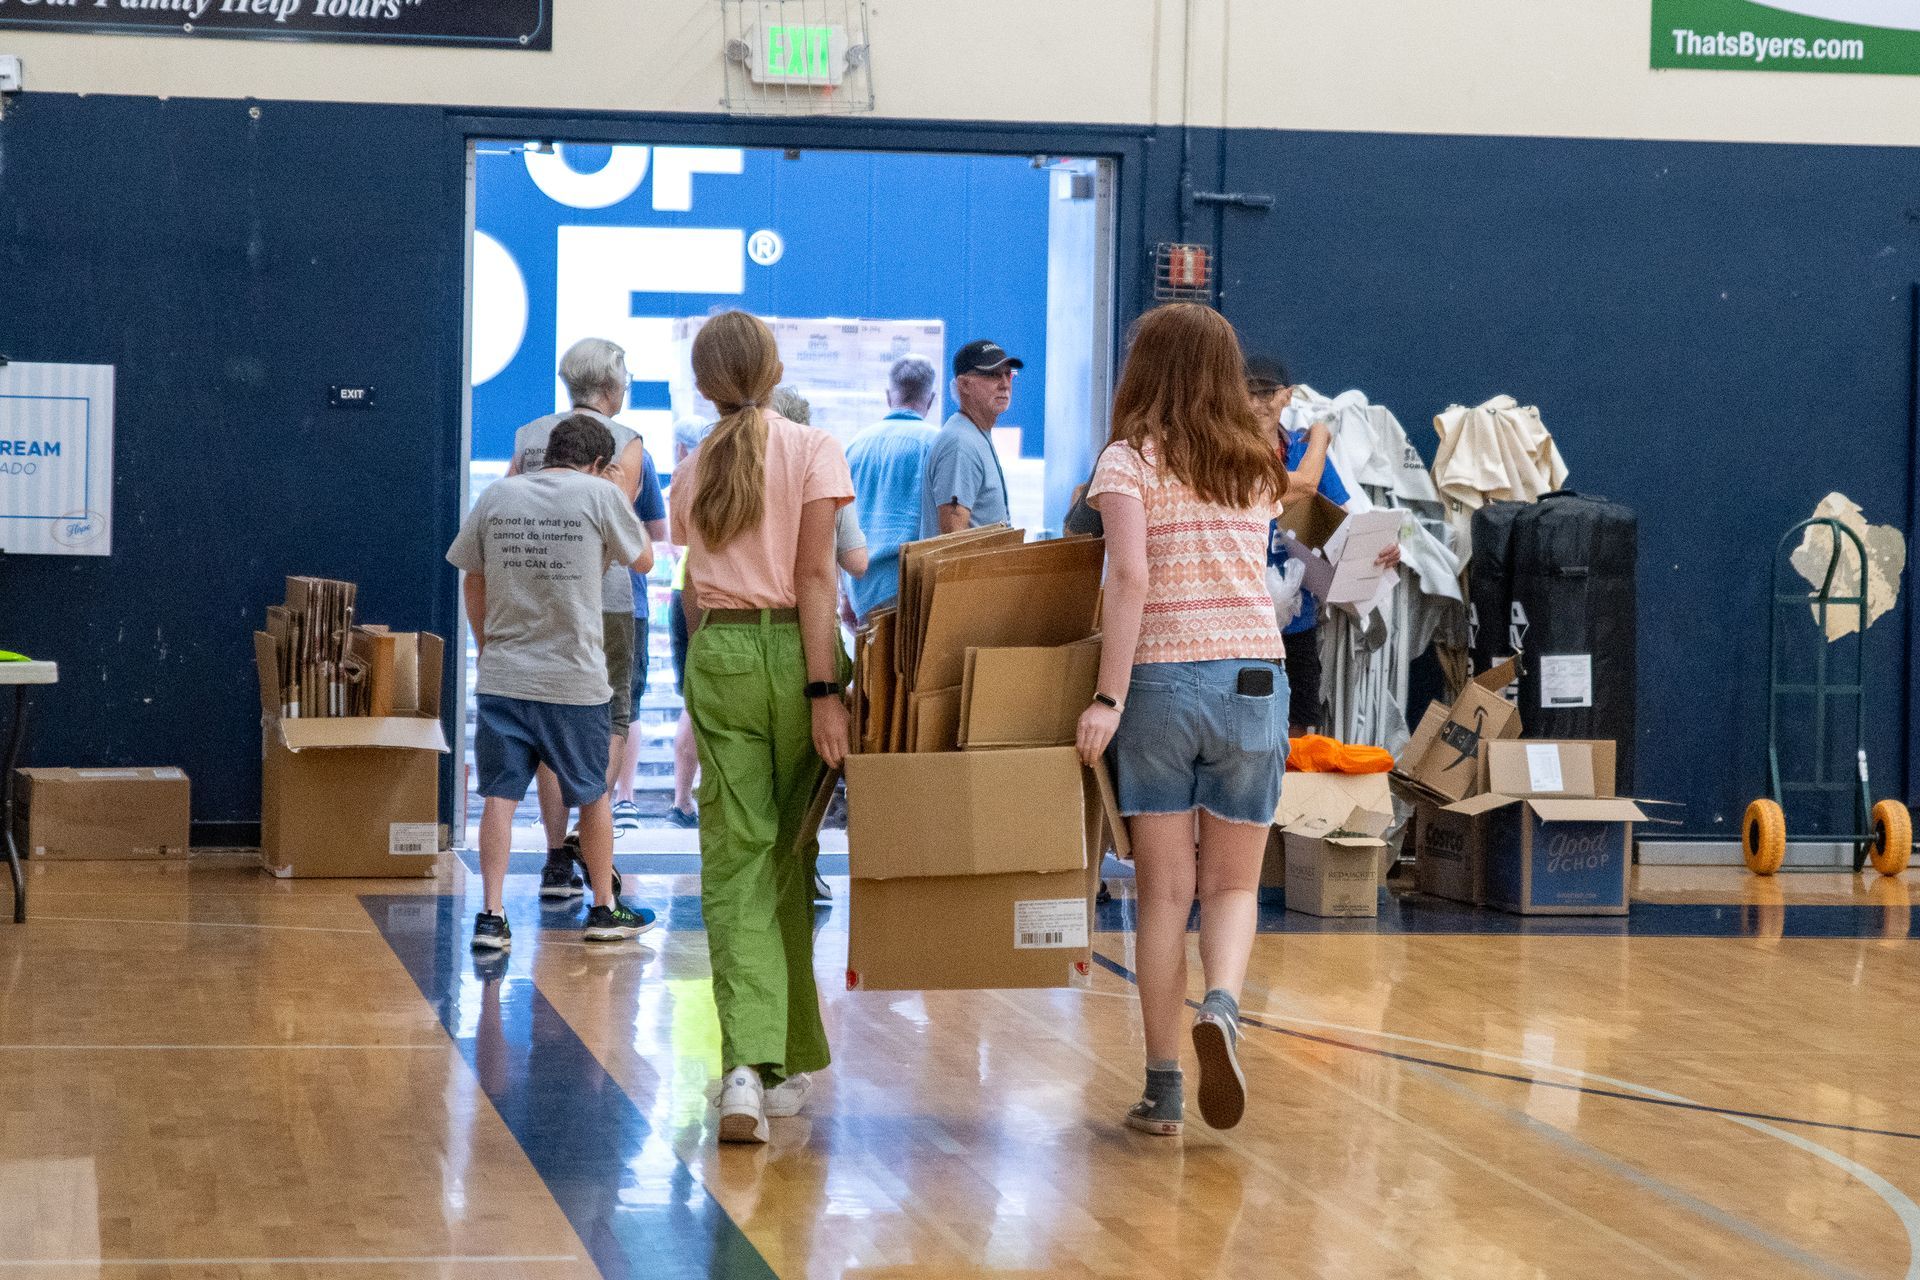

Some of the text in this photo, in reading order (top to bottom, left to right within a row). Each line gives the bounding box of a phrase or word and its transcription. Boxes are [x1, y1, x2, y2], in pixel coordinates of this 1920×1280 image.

[768, 26, 832, 76] EXIT
[1672, 29, 1865, 63] ThatsByers.com
[340, 388, 364, 399] EXIT
[0, 462, 37, 475] ADO
[505, 517, 521, 525] not
[523, 516, 536, 526] let
[538, 517, 561, 527] what
[563, 519, 581, 529] you
[493, 531, 583, 542] cannot do interfere
[501, 544, 548, 555] with what
[503, 560, 521, 569] you
[525, 559, 546, 569] CAN
[1560, 853, 1610, 872] CHOP
